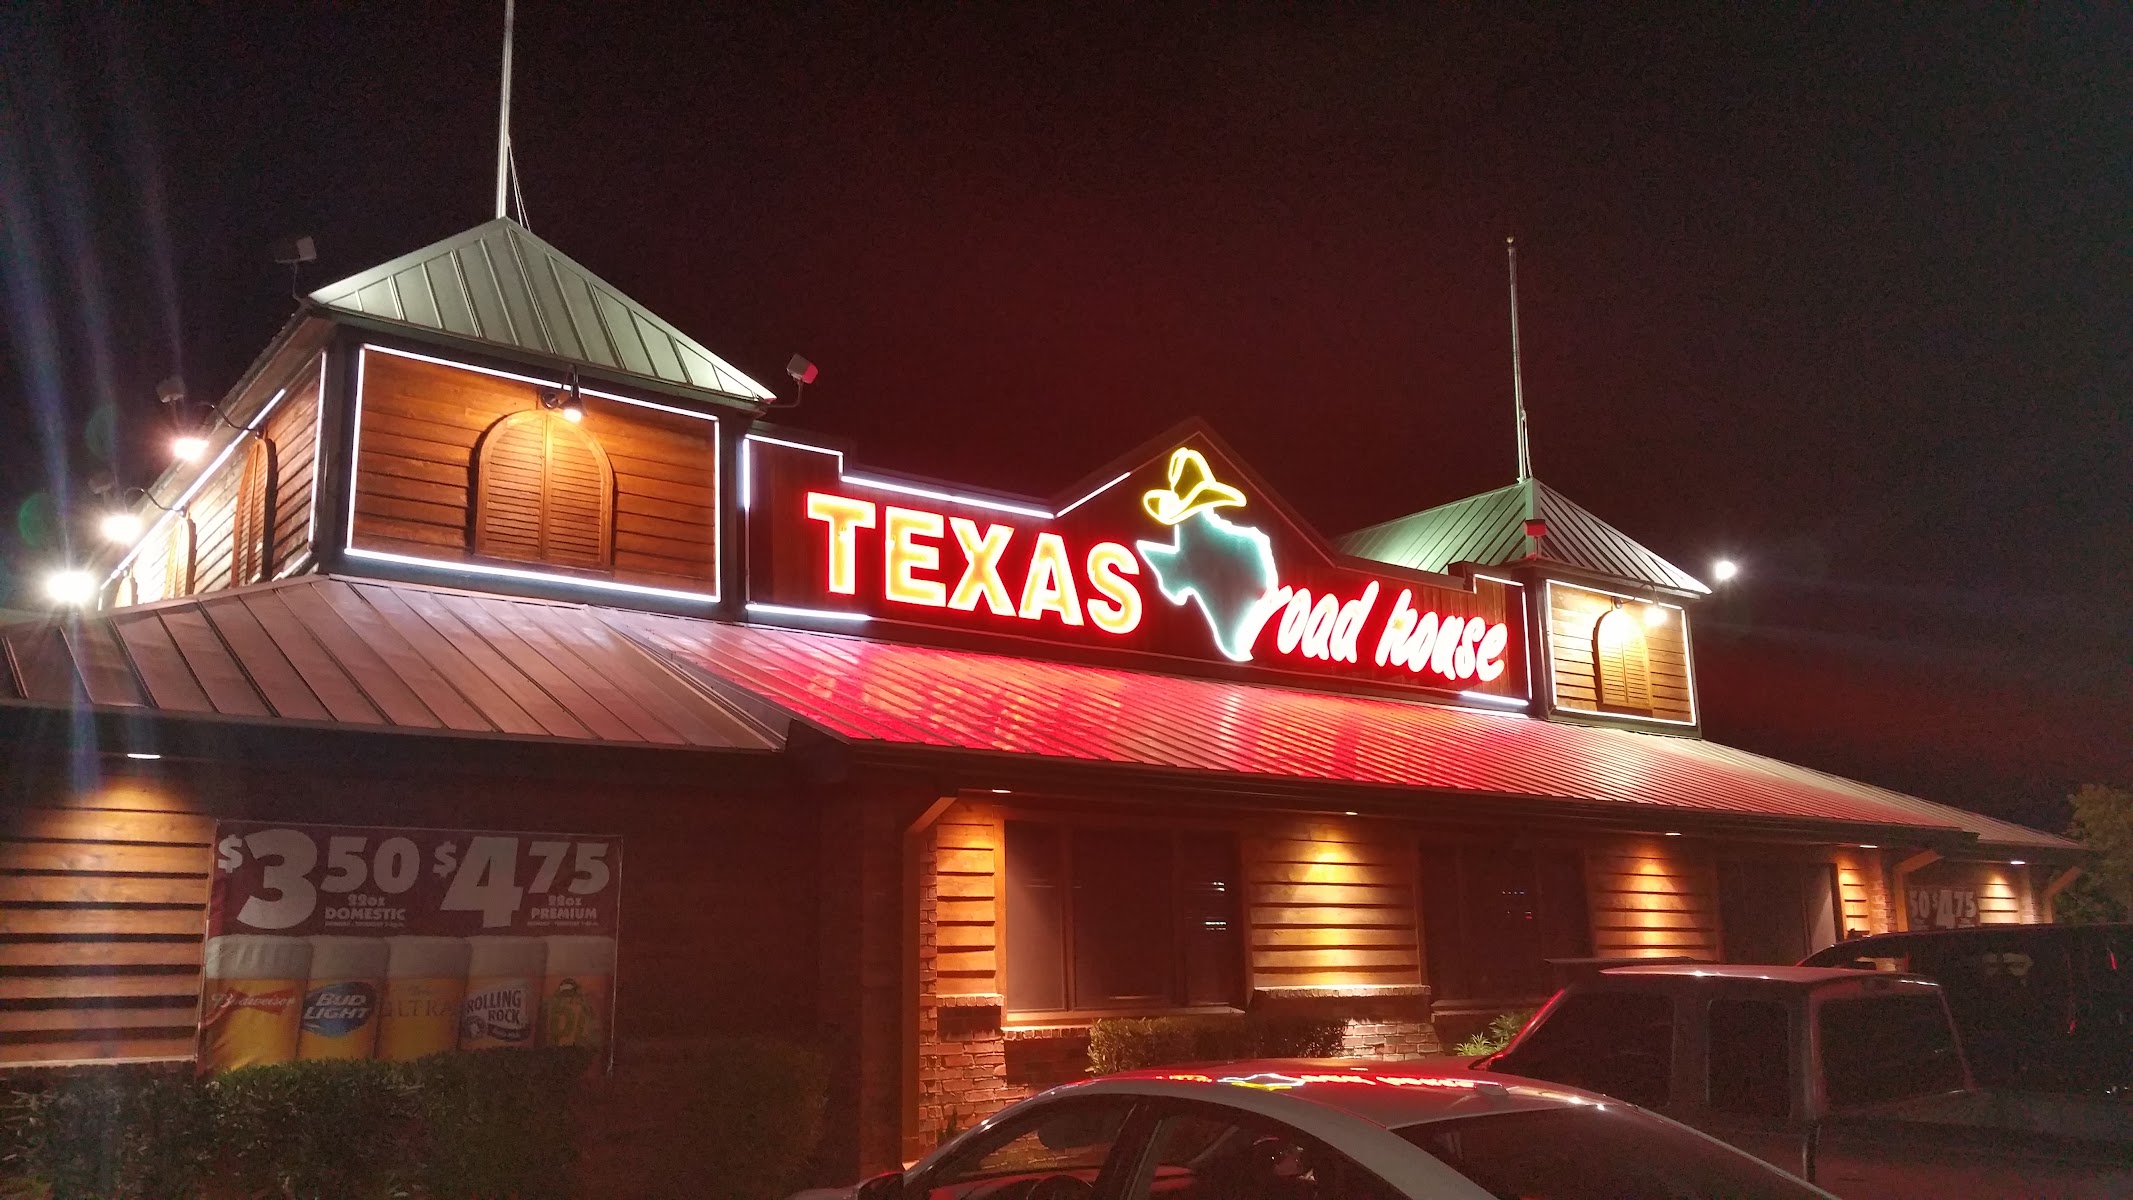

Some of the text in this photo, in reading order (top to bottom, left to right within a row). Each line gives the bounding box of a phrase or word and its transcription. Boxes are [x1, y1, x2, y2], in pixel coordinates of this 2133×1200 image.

[807, 491, 1143, 634] TEXAS
[1244, 580, 1508, 682] road house
[325, 908, 406, 921] DOMESTIC
[531, 908, 597, 921] PREMIUM
[466, 989, 522, 1014] ROLLING
[488, 1009, 521, 1023] ROCK
